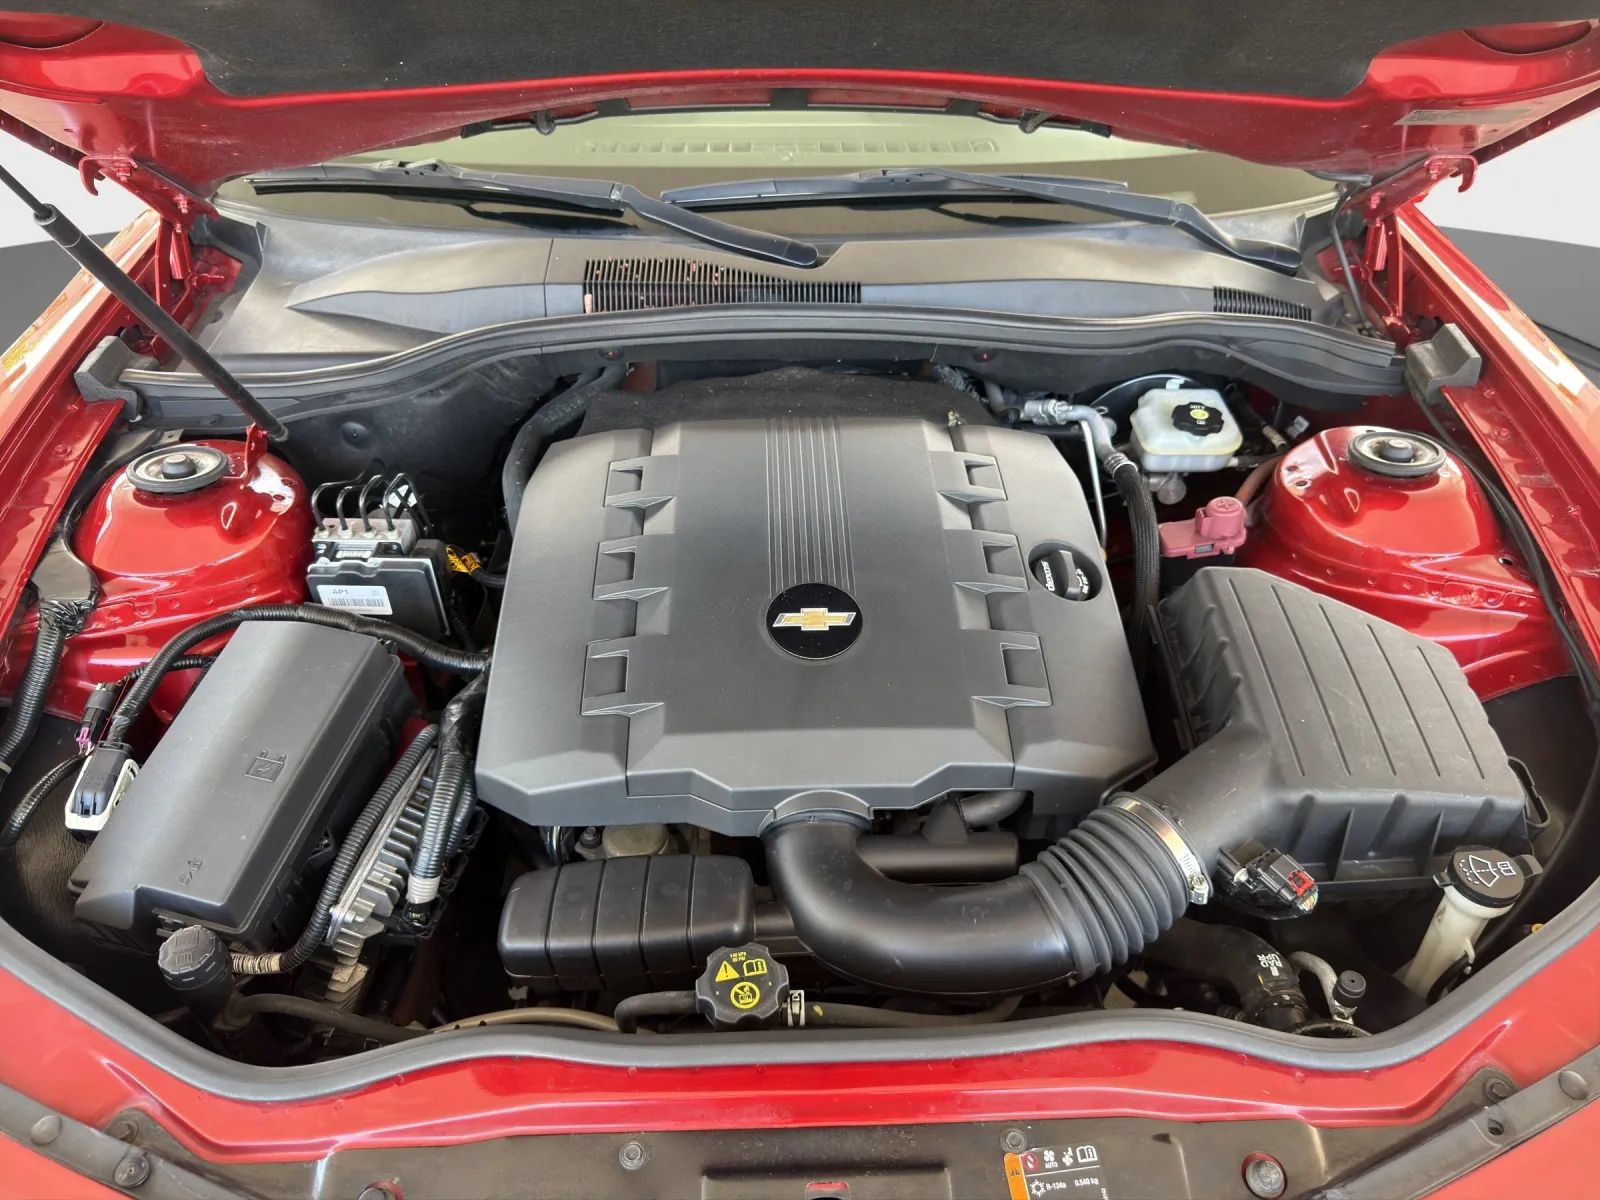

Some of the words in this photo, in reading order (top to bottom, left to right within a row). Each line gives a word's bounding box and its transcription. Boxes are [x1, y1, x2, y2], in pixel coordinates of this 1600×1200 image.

[1256, 953, 1280, 961] UPR
[1260, 959, 1283, 968] RAD
[1045, 1161, 1058, 1169] AUTO
[1090, 1177, 1099, 1185] kg
[1046, 1182, 1067, 1191] R-134a
